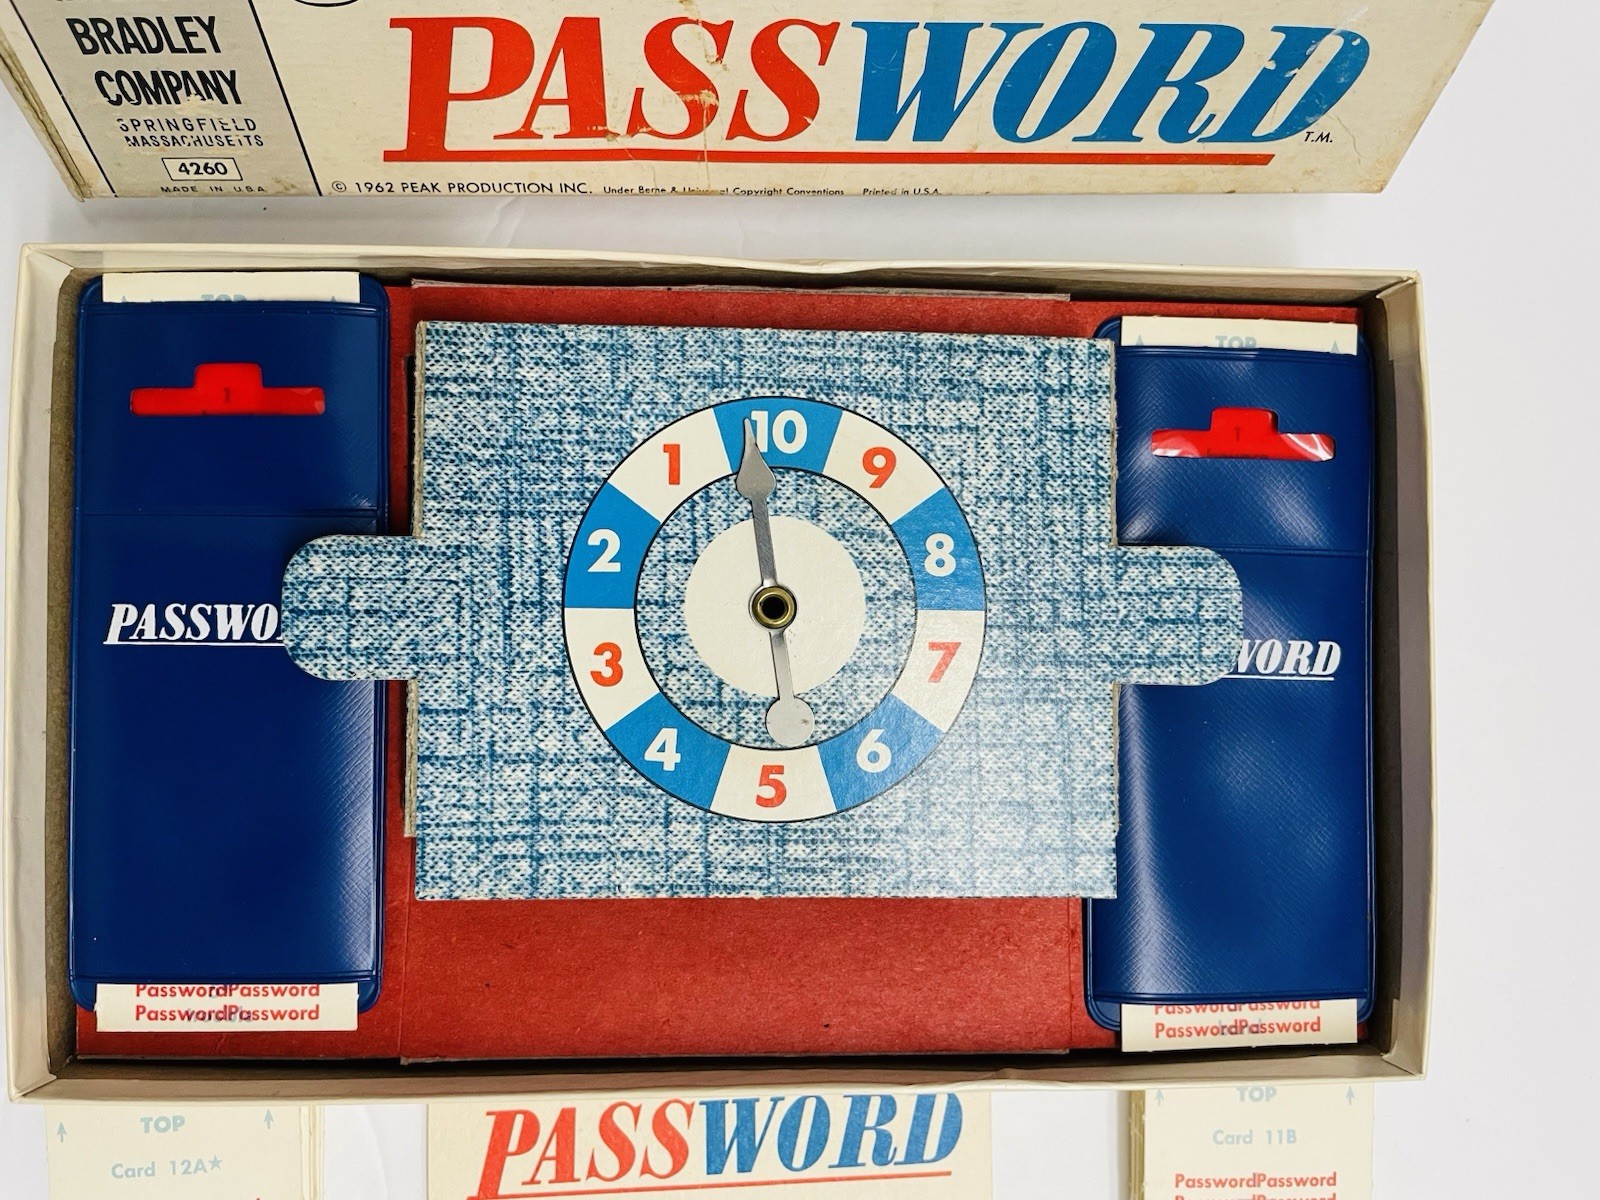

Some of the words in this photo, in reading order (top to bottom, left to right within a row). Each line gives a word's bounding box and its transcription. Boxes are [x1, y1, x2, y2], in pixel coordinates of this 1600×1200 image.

[65, 15, 222, 56] BRADLEY
[94, 69, 242, 106] COMPANY
[385, 16, 1370, 163] PASSWORD
[116, 117, 257, 132] SPRINGFIELD
[1304, 131, 1333, 143] T.M.
[160, 185, 199, 193] MADE
[178, 162, 228, 175] 4260
[355, 181, 395, 193] 1962
[401, 182, 440, 194] PEAK
[448, 182, 553, 194] PRODUCTION
[560, 182, 593, 194] INC.
[603, 186, 634, 194] Under
[638, 186, 666, 194] Berne
[733, 187, 782, 196] Copyright
[786, 187, 844, 196] Conventions
[1215, 335, 1257, 348] TOP
[749, 410, 808, 456] 10
[662, 443, 681, 486] 1
[861, 446, 897, 489] 9
[587, 529, 621, 573] 2
[924, 533, 957, 577] 8
[103, 603, 284, 645] PASSWO
[589, 642, 624, 687] 3
[927, 642, 962, 683] 7
[644, 728, 681, 771] 4
[856, 729, 892, 774] 6
[755, 765, 788, 808] 5
[1236, 1085, 1277, 1102] TOP
[140, 1115, 186, 1134] TOP
[1212, 1129, 1253, 1145] Card
[1266, 1129, 1297, 1145] 11B
[467, 1092, 963, 1200] PASSWORD
[111, 1161, 156, 1179] Card
